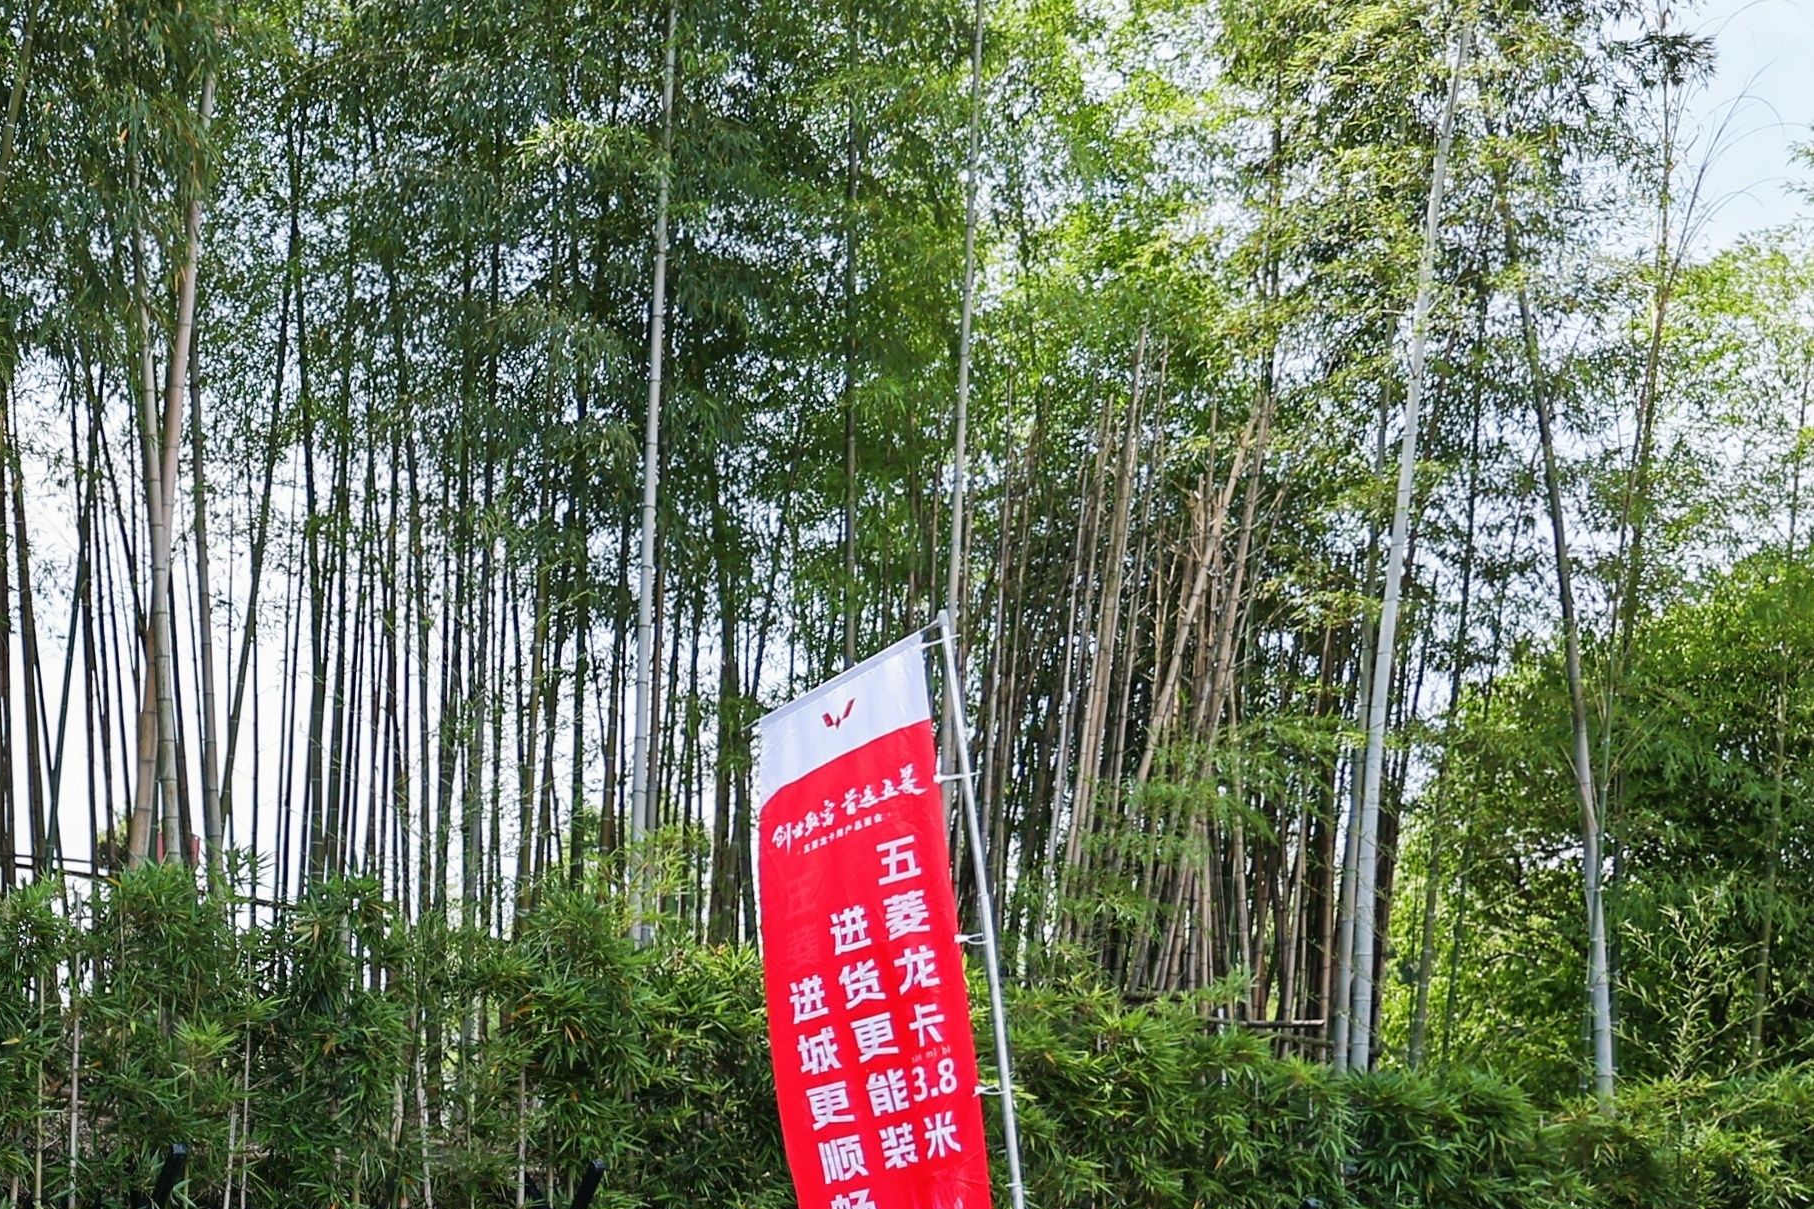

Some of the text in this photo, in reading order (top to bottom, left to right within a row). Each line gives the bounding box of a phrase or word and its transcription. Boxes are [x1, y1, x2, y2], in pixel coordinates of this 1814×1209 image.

[829, 904, 920, 1170] 进货更能装
